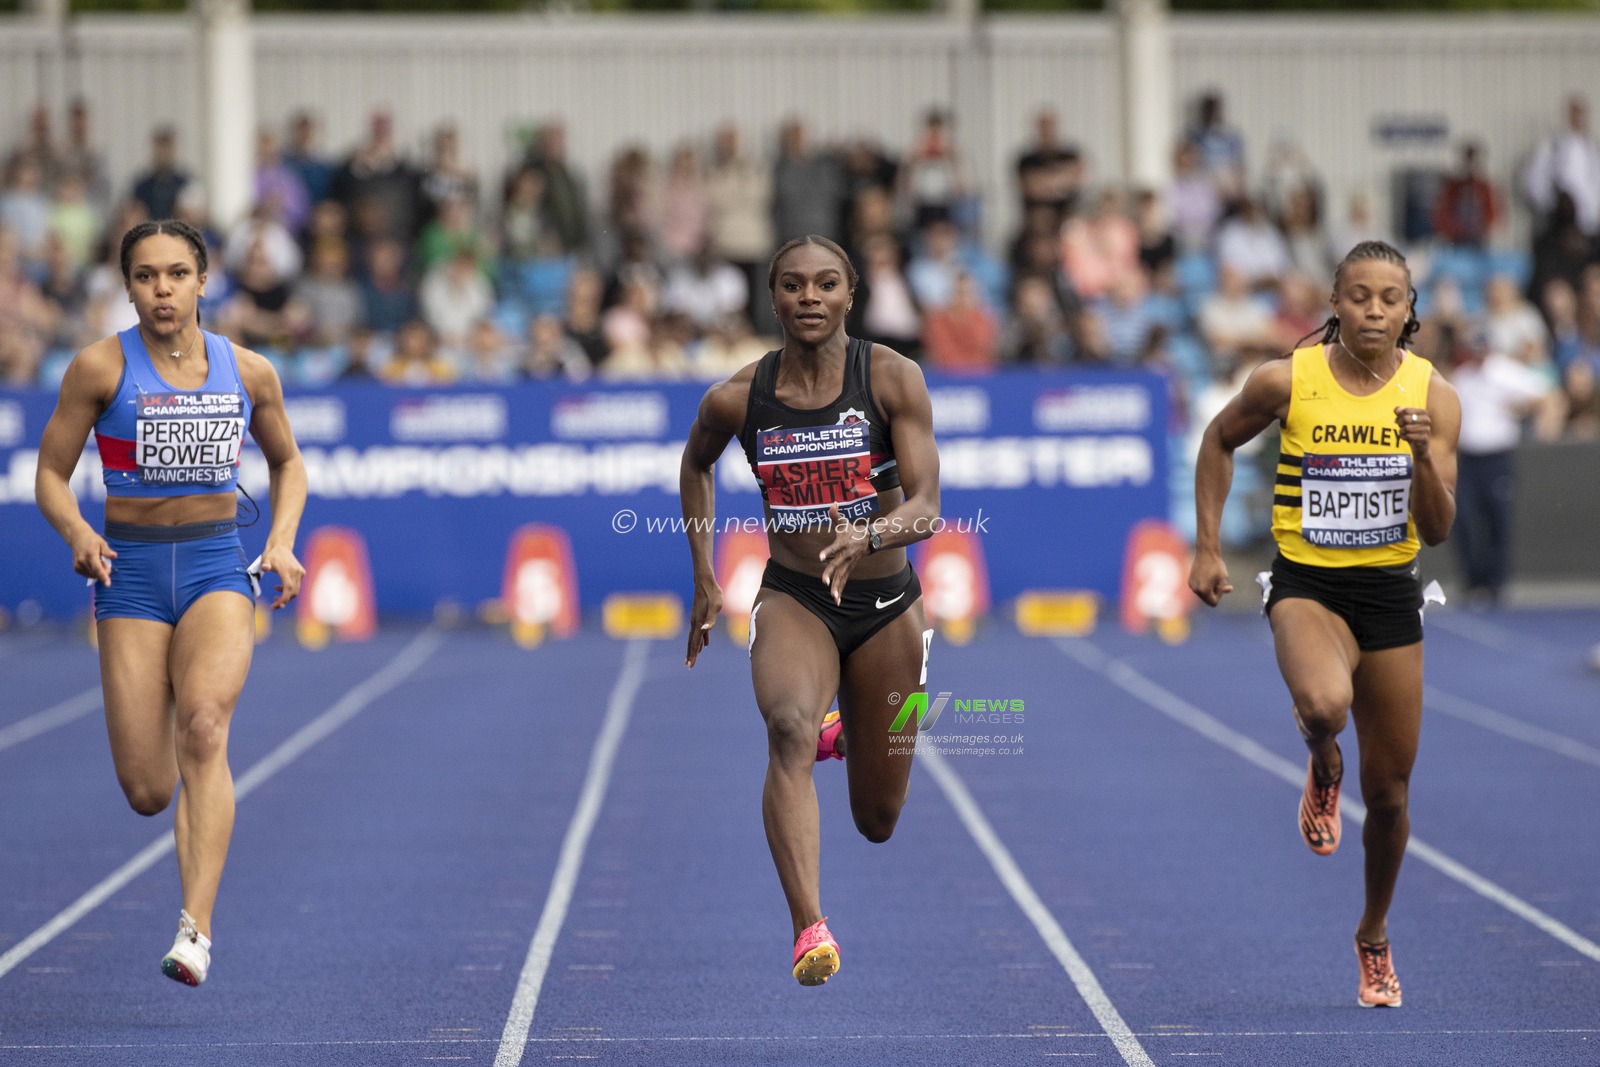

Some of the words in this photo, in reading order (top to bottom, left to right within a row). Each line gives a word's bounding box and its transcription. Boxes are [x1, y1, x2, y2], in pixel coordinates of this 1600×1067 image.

[143, 396, 162, 407] UK
[165, 394, 240, 406] ATHLETICS
[143, 404, 240, 415] CHAMPIONSHIPS
[142, 420, 240, 443] PERRUZZA
[787, 427, 863, 444] ATHLETICS
[1312, 425, 1401, 448] CRAWLEY
[142, 443, 235, 466] POWELL
[763, 438, 864, 456] CHAMPIONSHIPS
[771, 458, 861, 485] ASHER
[1307, 456, 1325, 467] UK
[1328, 456, 1408, 468] ATHLETICS
[143, 467, 232, 483] MANCHESTER
[1307, 467, 1408, 477] CHAMPIONSHIPS
[781, 479, 859, 505] SMITH
[1308, 488, 1405, 519] BAPTISTE
[777, 500, 873, 527] MANCHSTER
[1309, 527, 1403, 546] MANCHESTER
